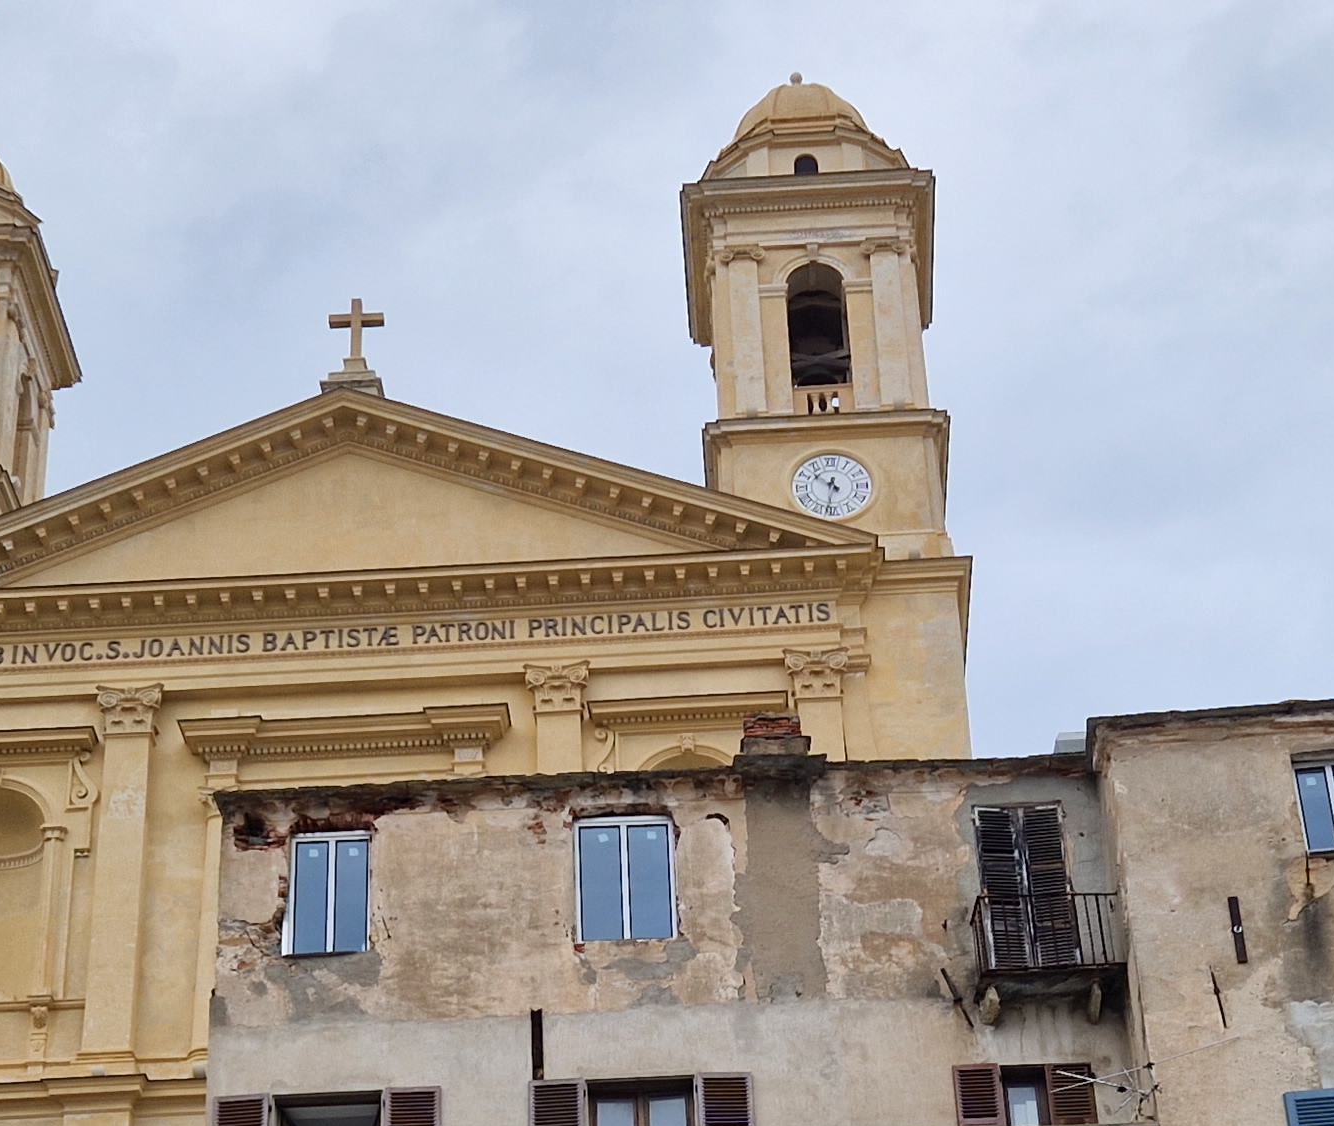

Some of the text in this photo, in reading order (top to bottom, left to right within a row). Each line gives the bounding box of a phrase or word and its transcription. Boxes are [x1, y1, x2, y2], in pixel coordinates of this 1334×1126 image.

[261, 626, 399, 653] BAPTISTÆ
[412, 619, 516, 645] PATRONI
[528, 611, 691, 638] PRINCIPALIS
[703, 603, 832, 629] CIVITATIS
